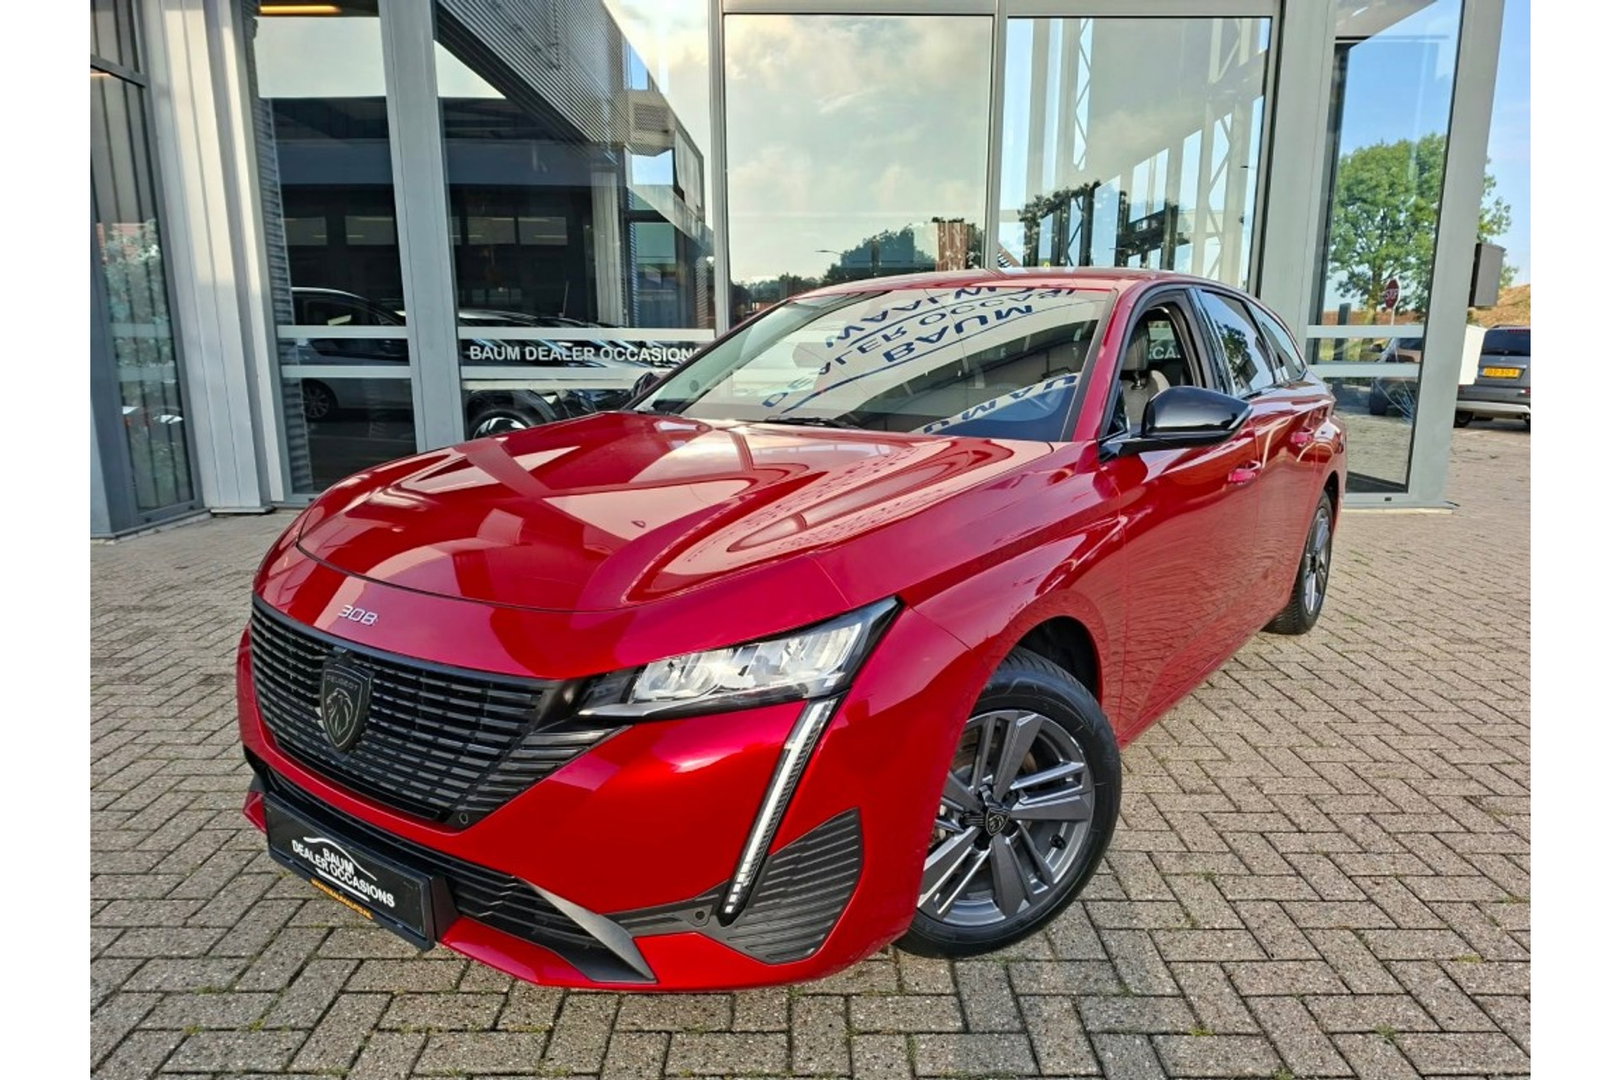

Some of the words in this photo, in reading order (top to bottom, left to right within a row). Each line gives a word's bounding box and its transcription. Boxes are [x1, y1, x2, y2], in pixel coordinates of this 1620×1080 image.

[470, 345, 520, 360] BAUM
[525, 346, 595, 361] DEALER
[338, 604, 378, 626] 308
[292, 839, 329, 872] DEALER
[329, 863, 396, 908] OCCASIONS
[322, 848, 355, 875] BAUM
